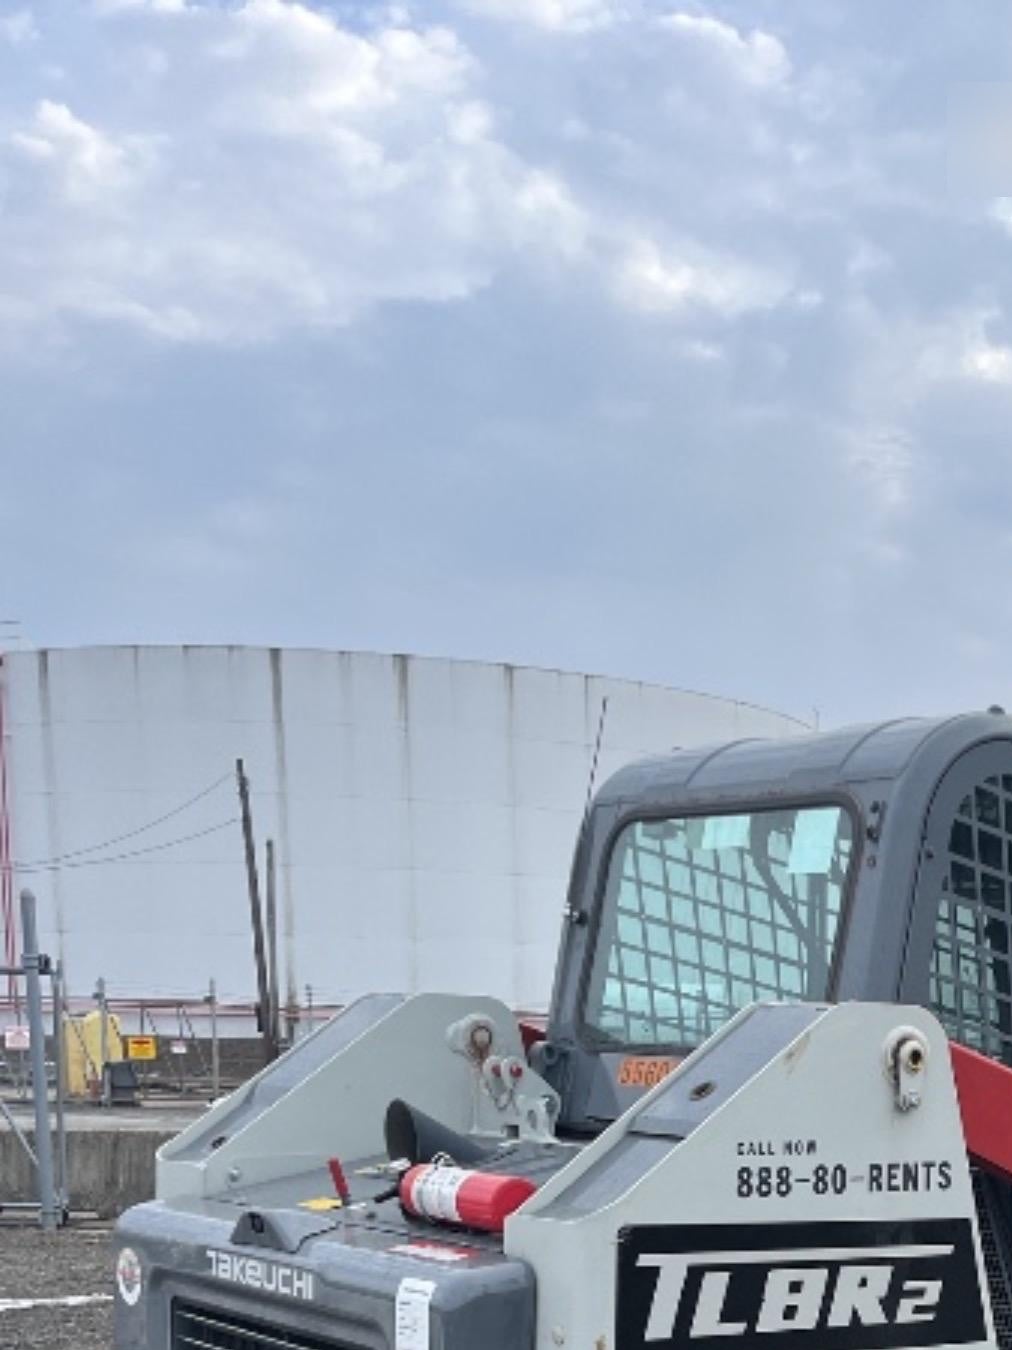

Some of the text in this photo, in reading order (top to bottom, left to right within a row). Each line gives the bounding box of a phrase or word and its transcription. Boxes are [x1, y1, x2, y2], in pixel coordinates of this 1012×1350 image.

[737, 1140, 817, 1156] CALL NOW
[736, 1161, 953, 1198] 888-80-RENTS
[206, 1250, 314, 1300] TAKEUCHI
